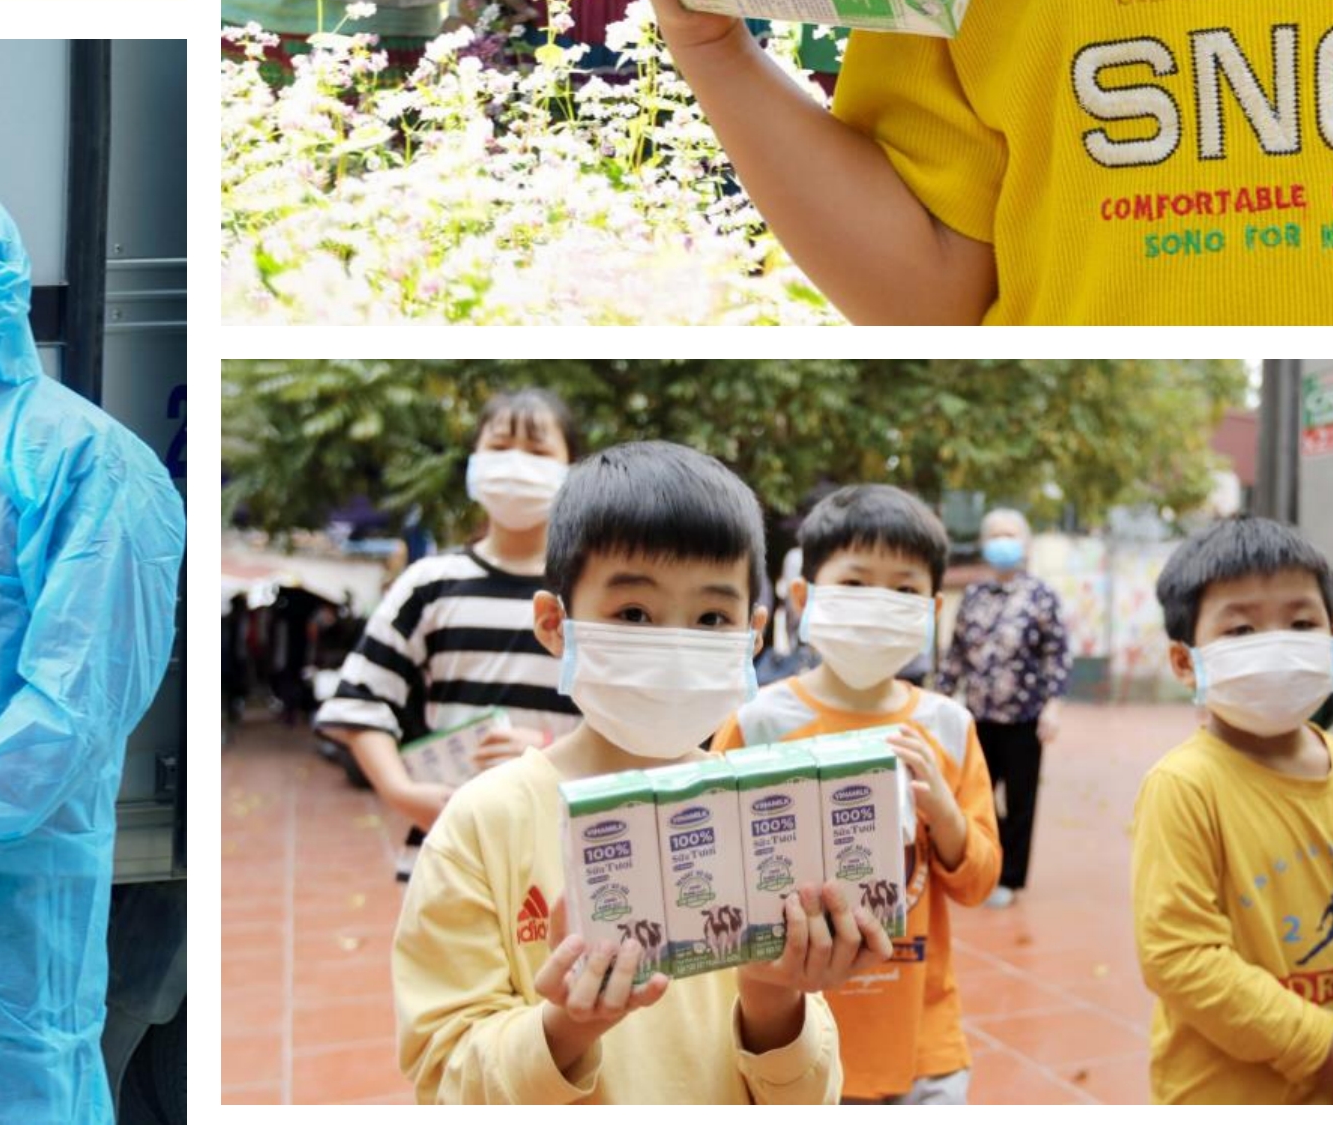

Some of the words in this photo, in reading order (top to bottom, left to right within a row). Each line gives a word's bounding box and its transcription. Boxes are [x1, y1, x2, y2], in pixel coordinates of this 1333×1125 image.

[1100, 185, 1307, 221] COMFORTABLE
[1145, 229, 1225, 259] SONO
[1246, 224, 1301, 249] FOR
[753, 817, 795, 836] 100%
[834, 807, 874, 824] 100%
[672, 828, 713, 850] 100%
[586, 841, 630, 863] 100%
